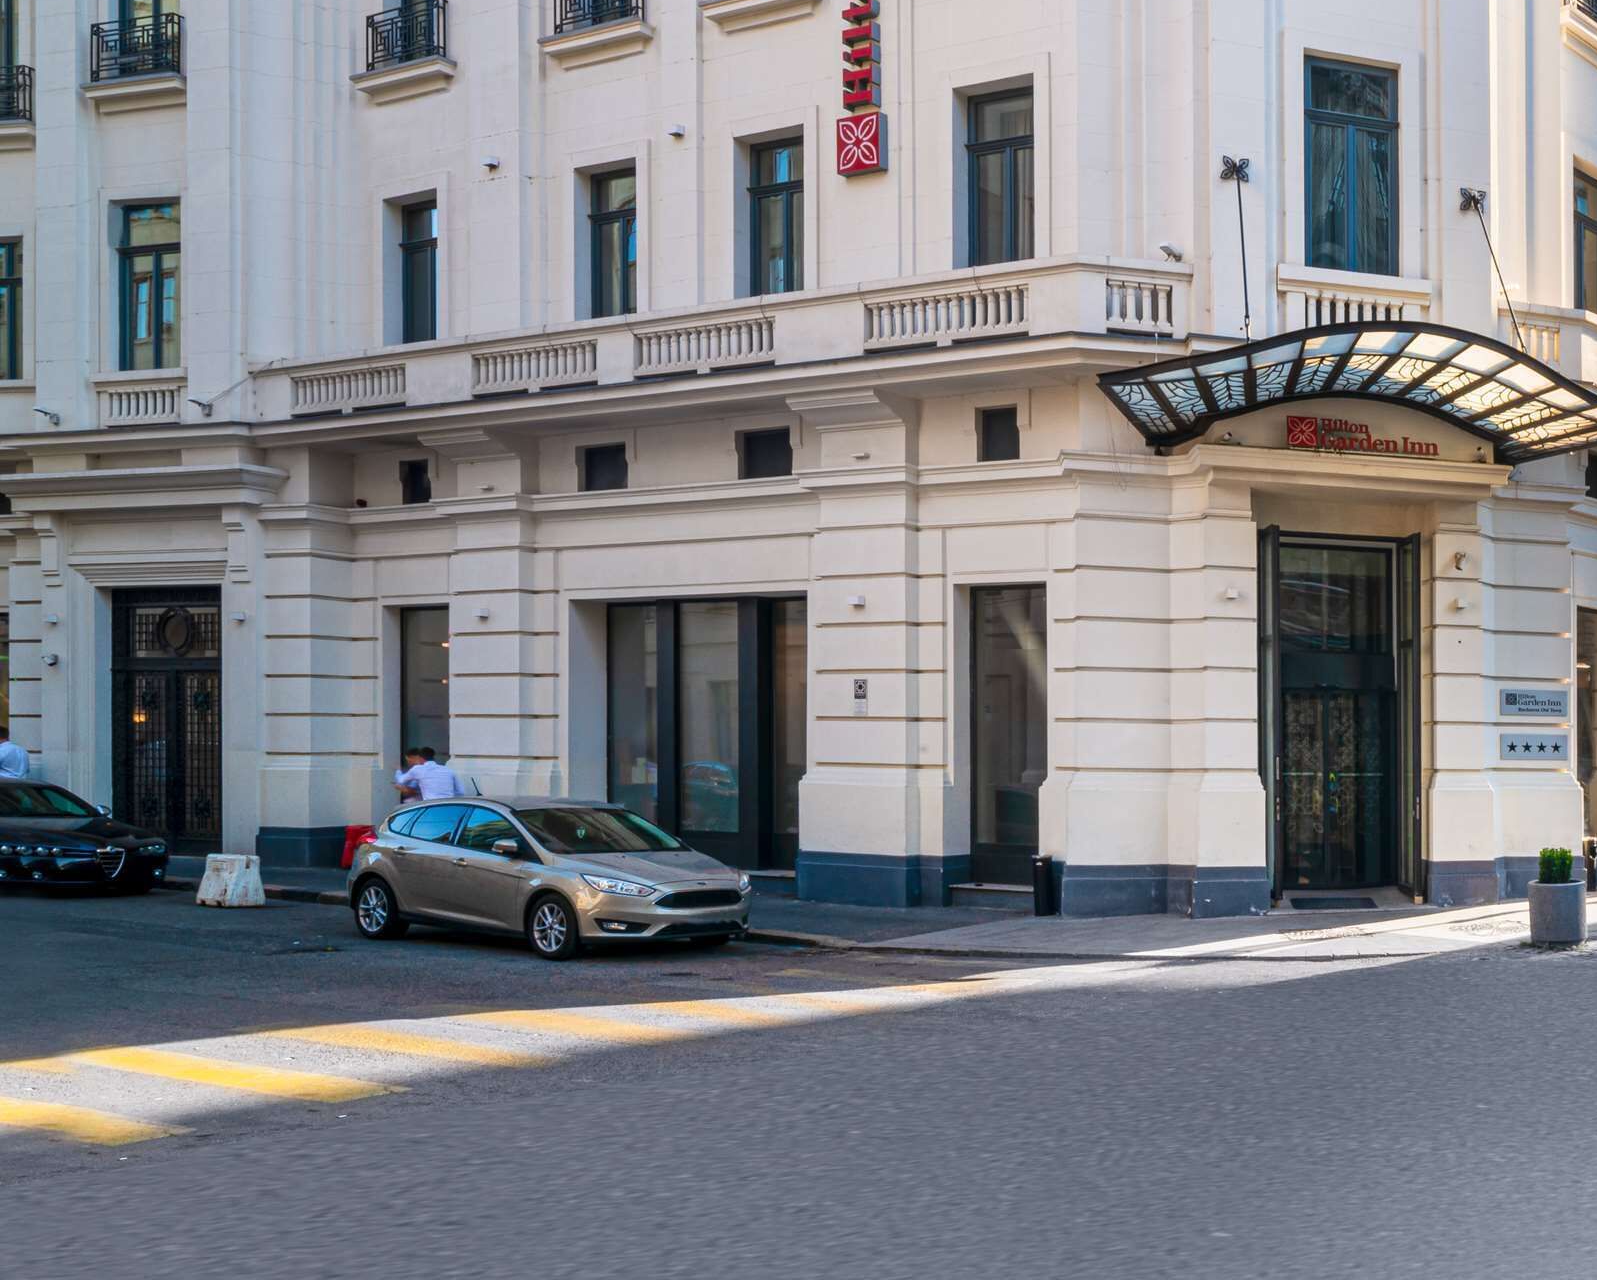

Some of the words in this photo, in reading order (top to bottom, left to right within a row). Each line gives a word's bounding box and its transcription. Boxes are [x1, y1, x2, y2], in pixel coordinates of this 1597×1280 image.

[1320, 418, 1369, 434] Hilton
[1320, 434, 1398, 453] Garden
[1402, 437, 1439, 456] Inn
